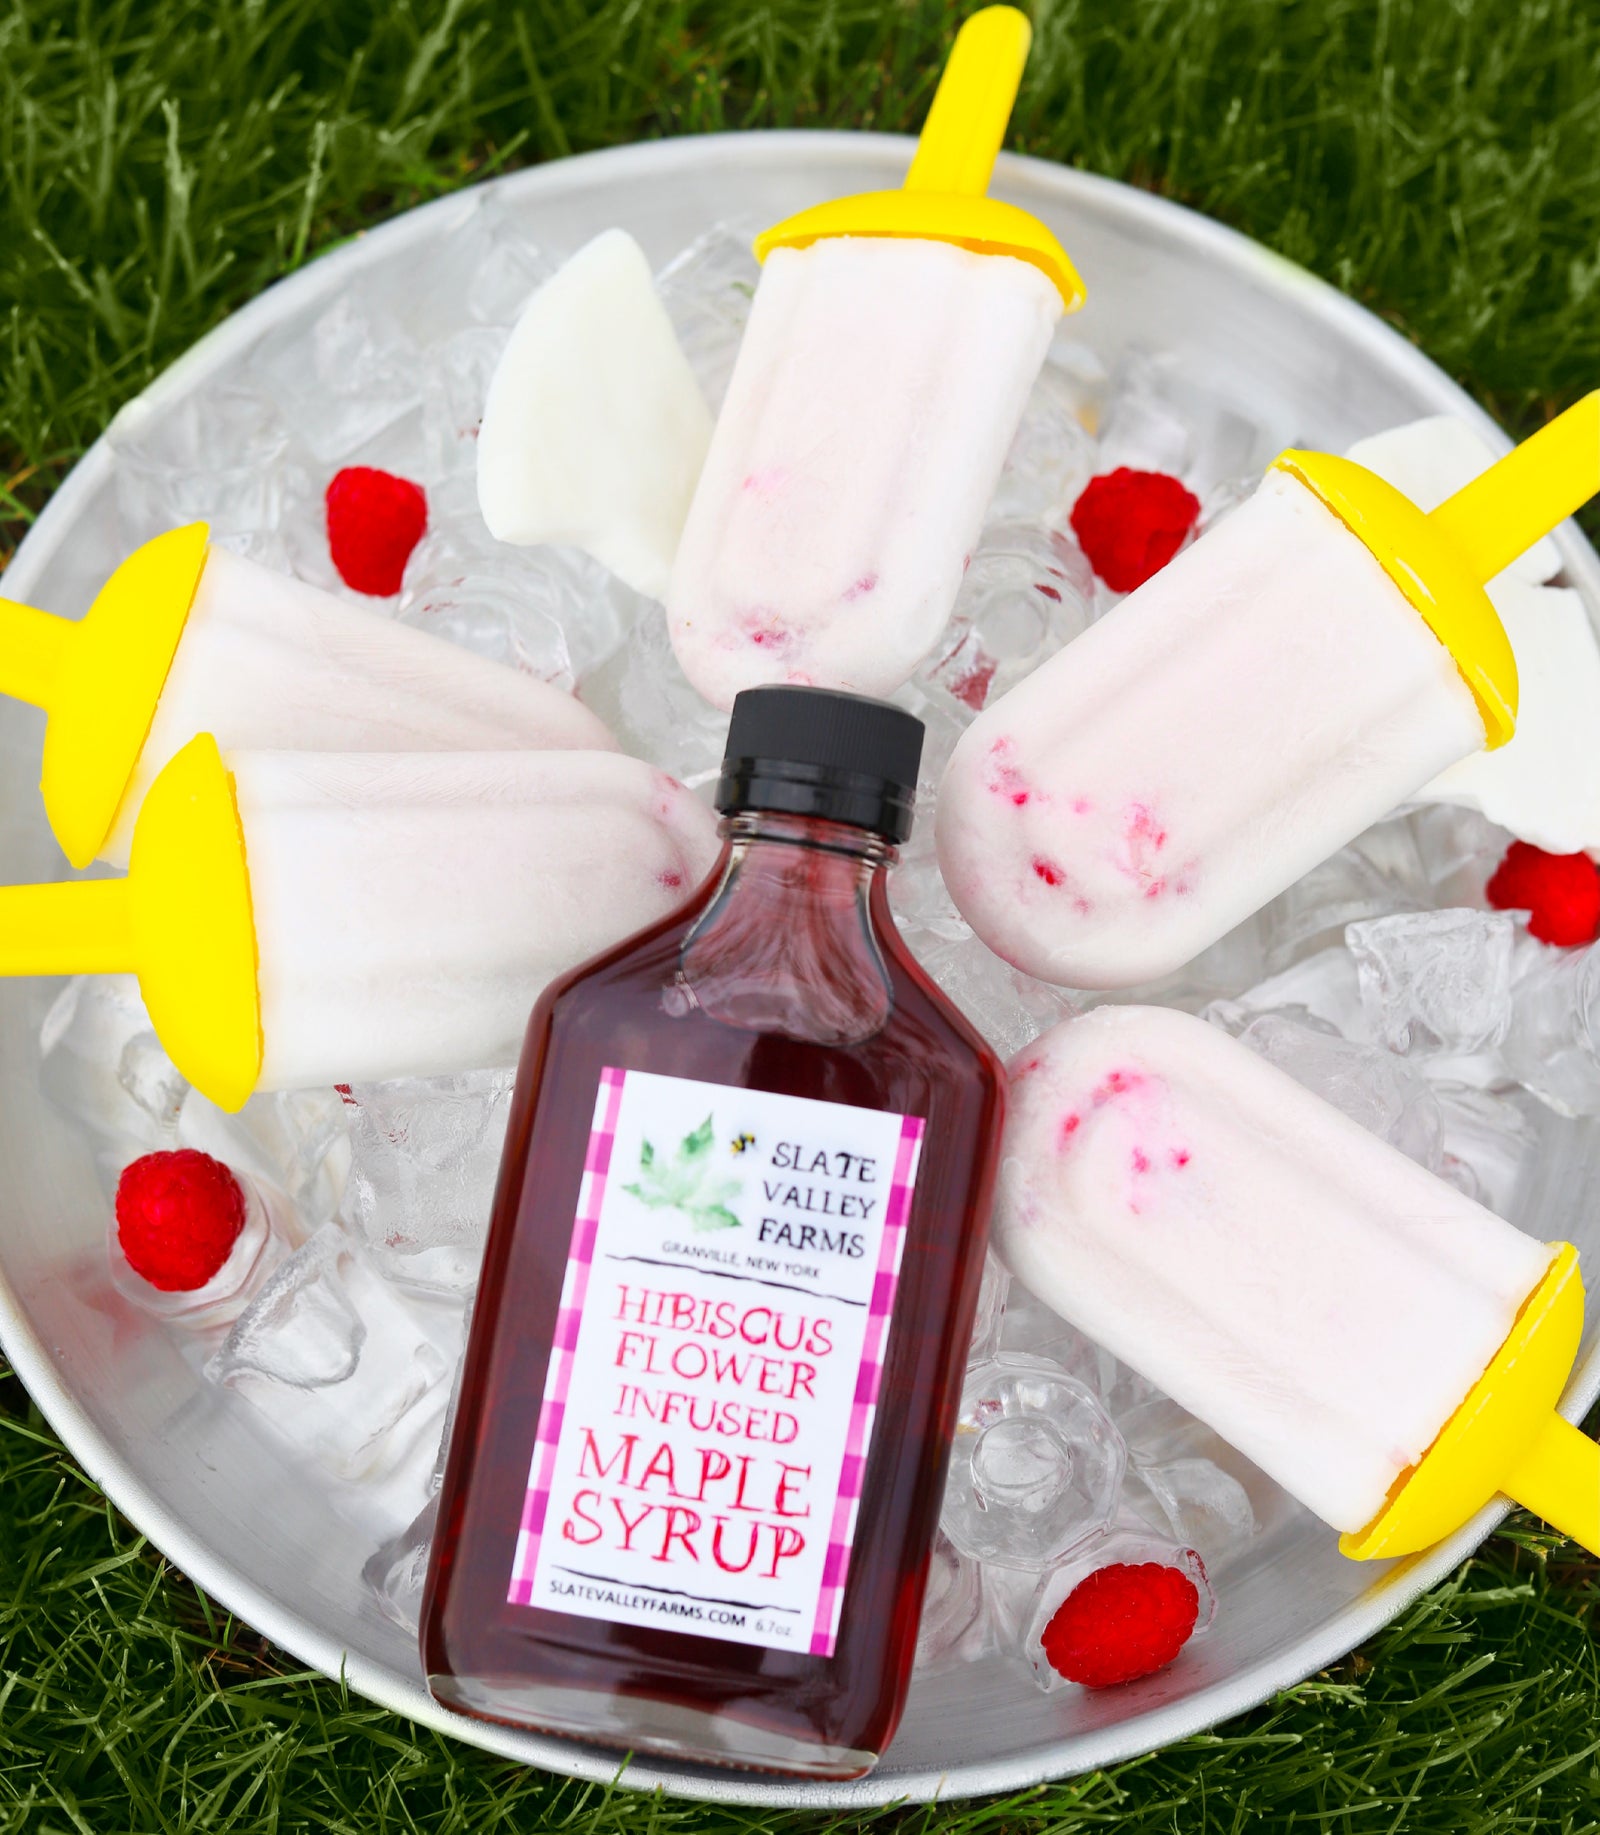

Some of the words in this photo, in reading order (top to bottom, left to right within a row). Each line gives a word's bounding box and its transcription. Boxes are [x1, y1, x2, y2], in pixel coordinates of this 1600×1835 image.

[771, 1142, 876, 1182] SLATE
[763, 1181, 876, 1219] VALLEY
[757, 1218, 865, 1258] FARMS
[746, 1254, 780, 1273] NEW
[785, 1260, 820, 1280] YORK
[613, 1285, 833, 1356] HIBISCUS
[613, 1331, 818, 1400] FLOWER
[613, 1384, 799, 1444] INFUSED
[576, 1427, 812, 1518] MAPLE
[562, 1489, 806, 1578] SYRUP
[550, 1580, 747, 1627] SLATEVALLEYFARMS.COM
